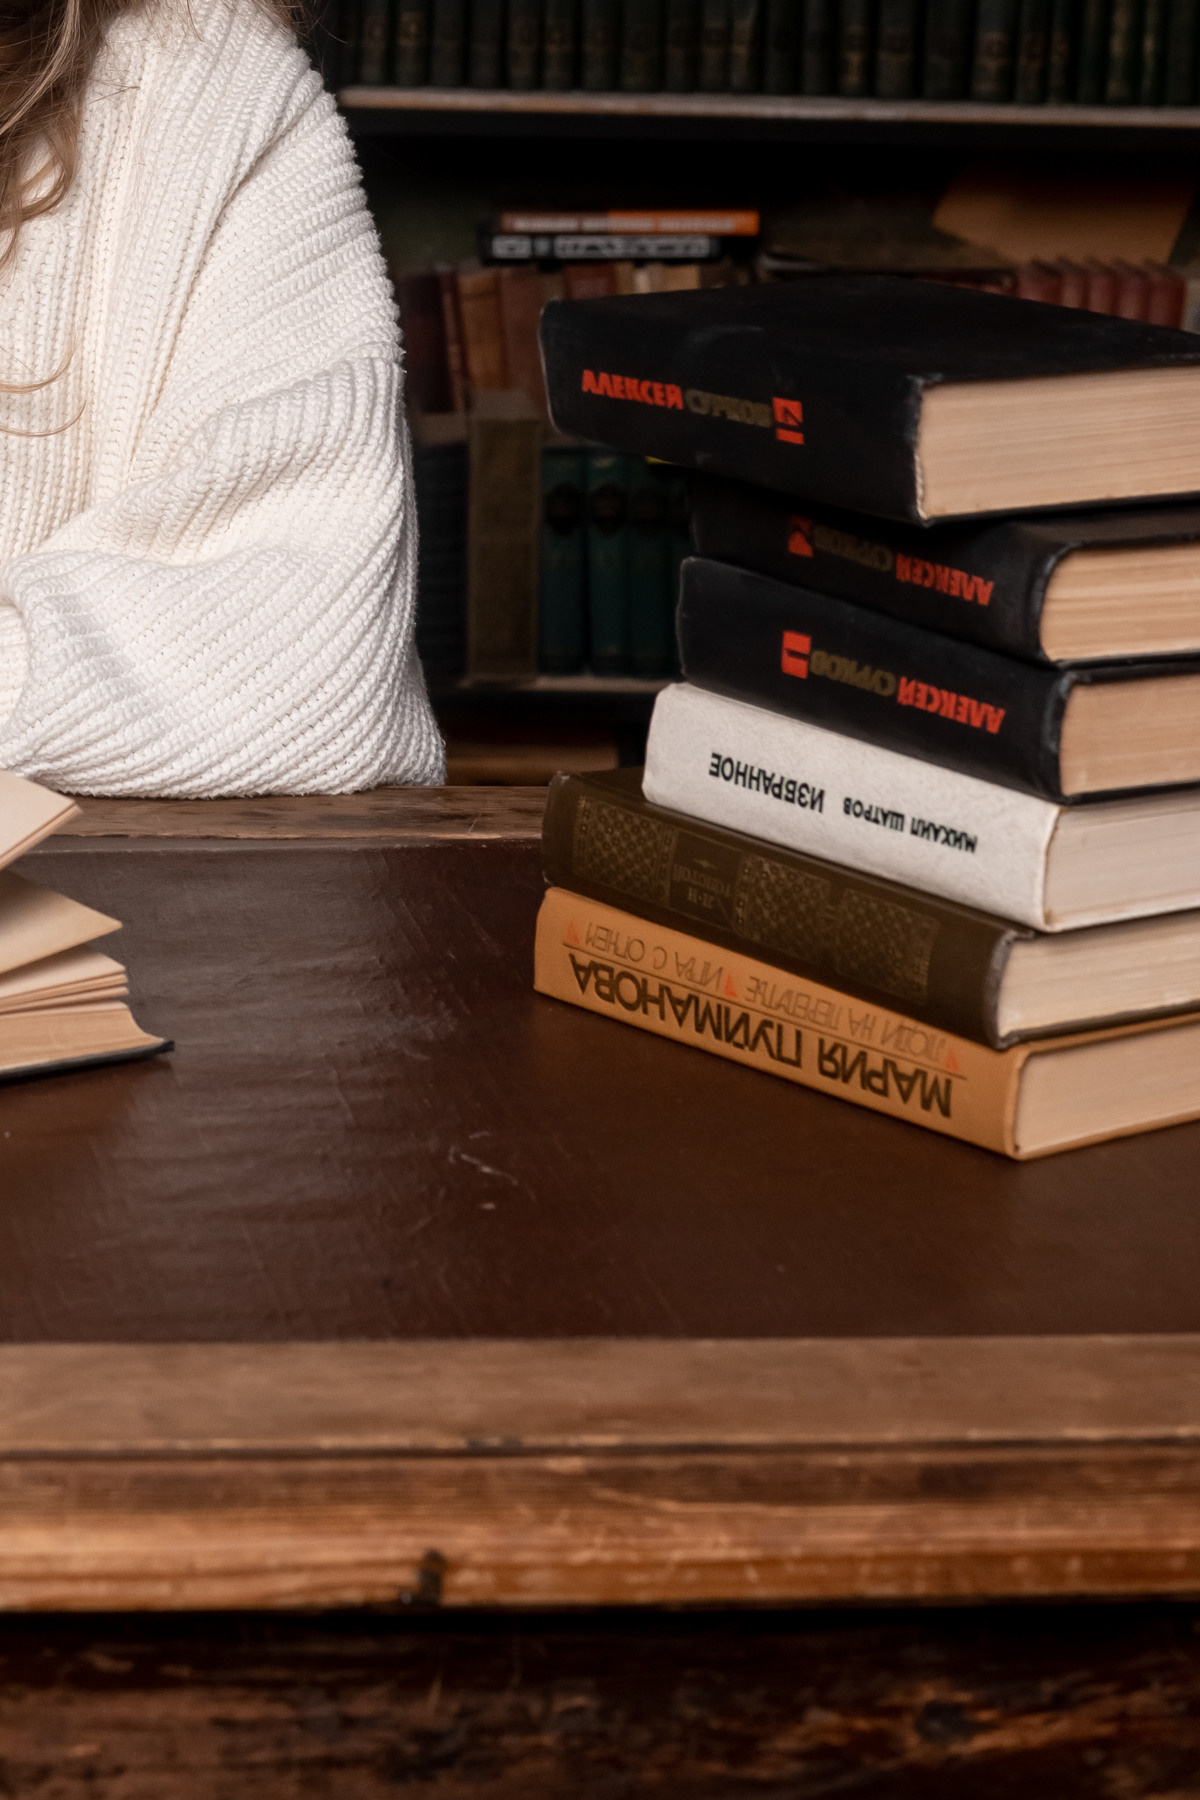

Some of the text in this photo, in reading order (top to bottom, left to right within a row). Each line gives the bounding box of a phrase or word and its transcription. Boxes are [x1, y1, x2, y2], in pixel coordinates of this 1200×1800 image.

[896, 553, 994, 606] АЛЕКСЕЙ
[809, 650, 897, 697] СУРКОВ
[897, 676, 1006, 734] АЛЕКСЕЙ
[709, 752, 978, 854] МИХАИЛ ШАТРОВ ИЗБРАННОЕ
[585, 922, 645, 963] ОГНЕМ
[652, 946, 668, 971] С
[675, 951, 723, 991] ИГРА
[568, 953, 952, 1118] МАРИЯ ПУЙМАНОВА
[849, 1008, 877, 1042] НА
